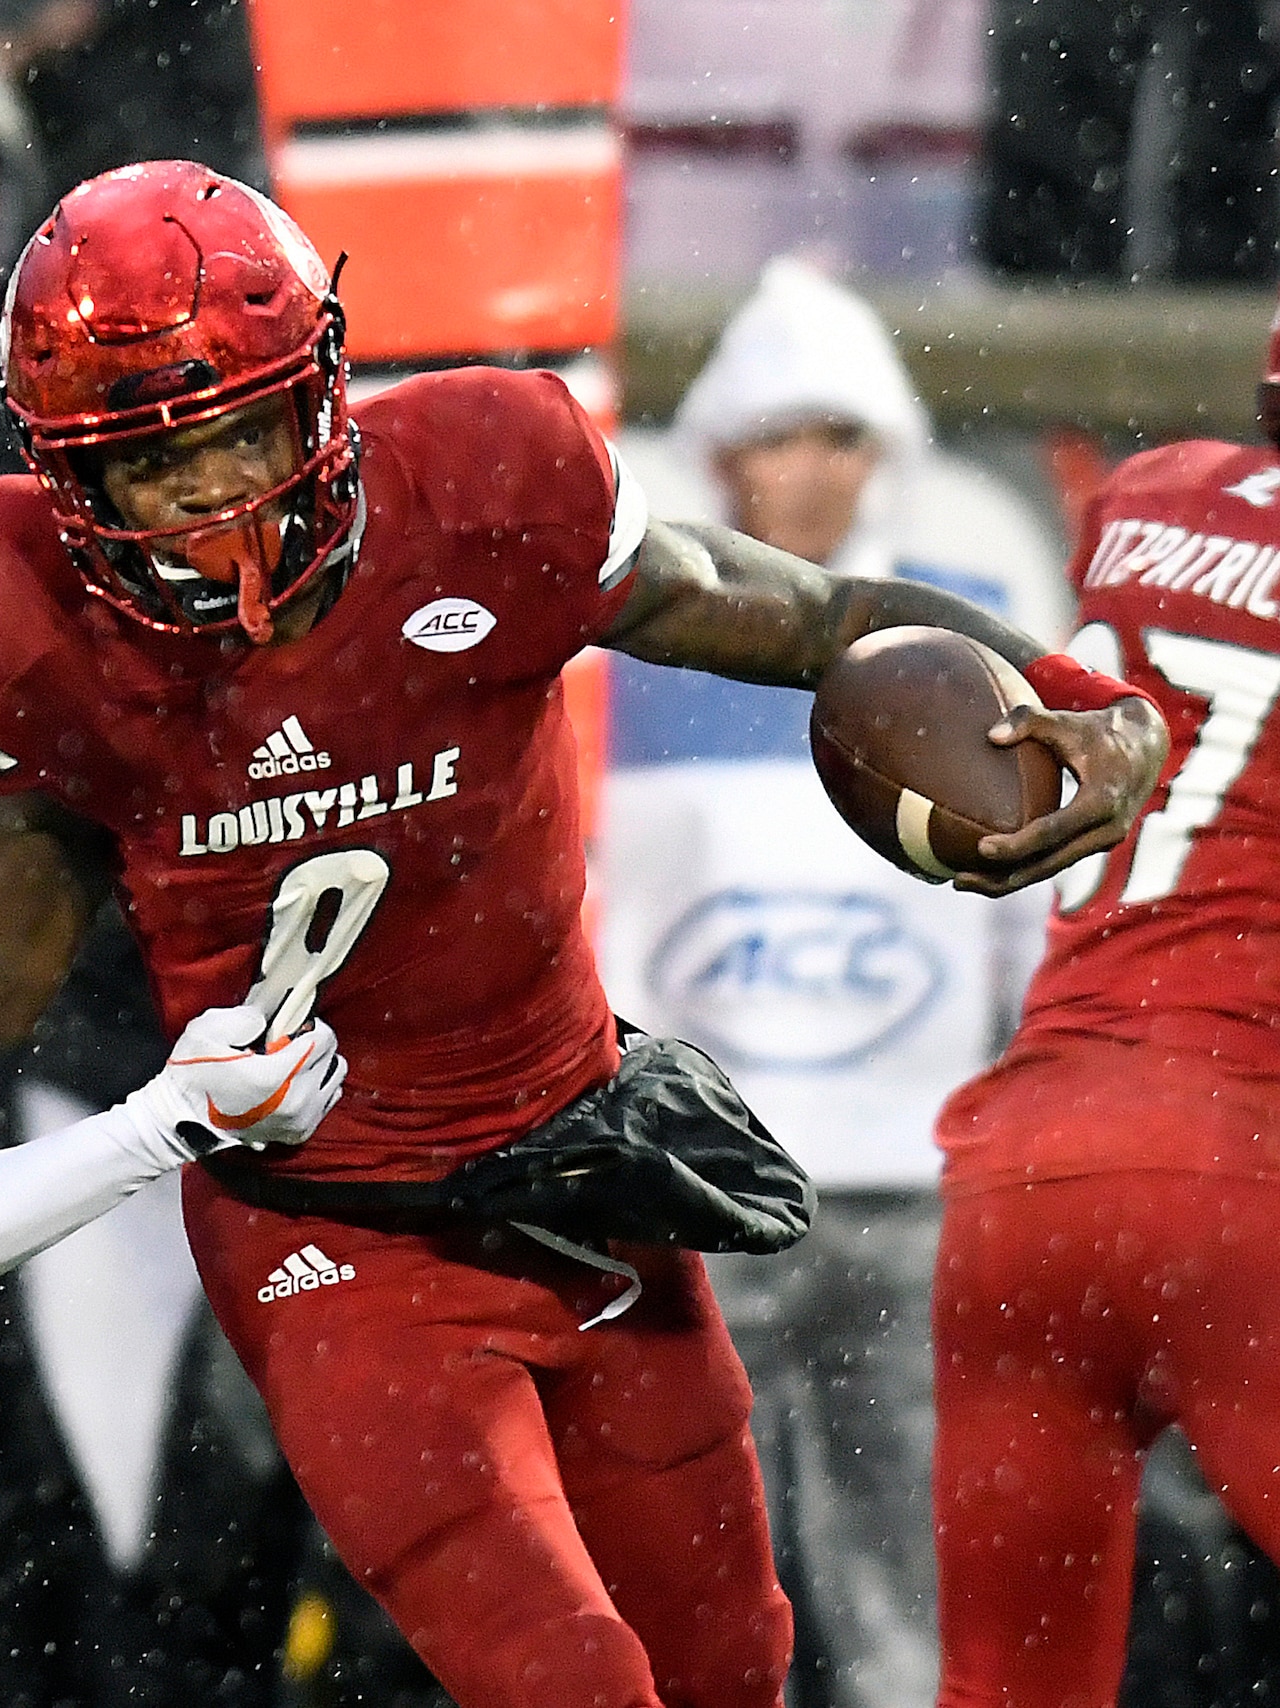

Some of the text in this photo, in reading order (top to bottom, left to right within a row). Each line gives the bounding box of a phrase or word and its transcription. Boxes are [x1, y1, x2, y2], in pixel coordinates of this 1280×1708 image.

[417, 609, 482, 634] ACC
[247, 750, 332, 780] adidas
[179, 746, 461, 857] LOUISVILLE
[257, 1264, 356, 1303] adidas
